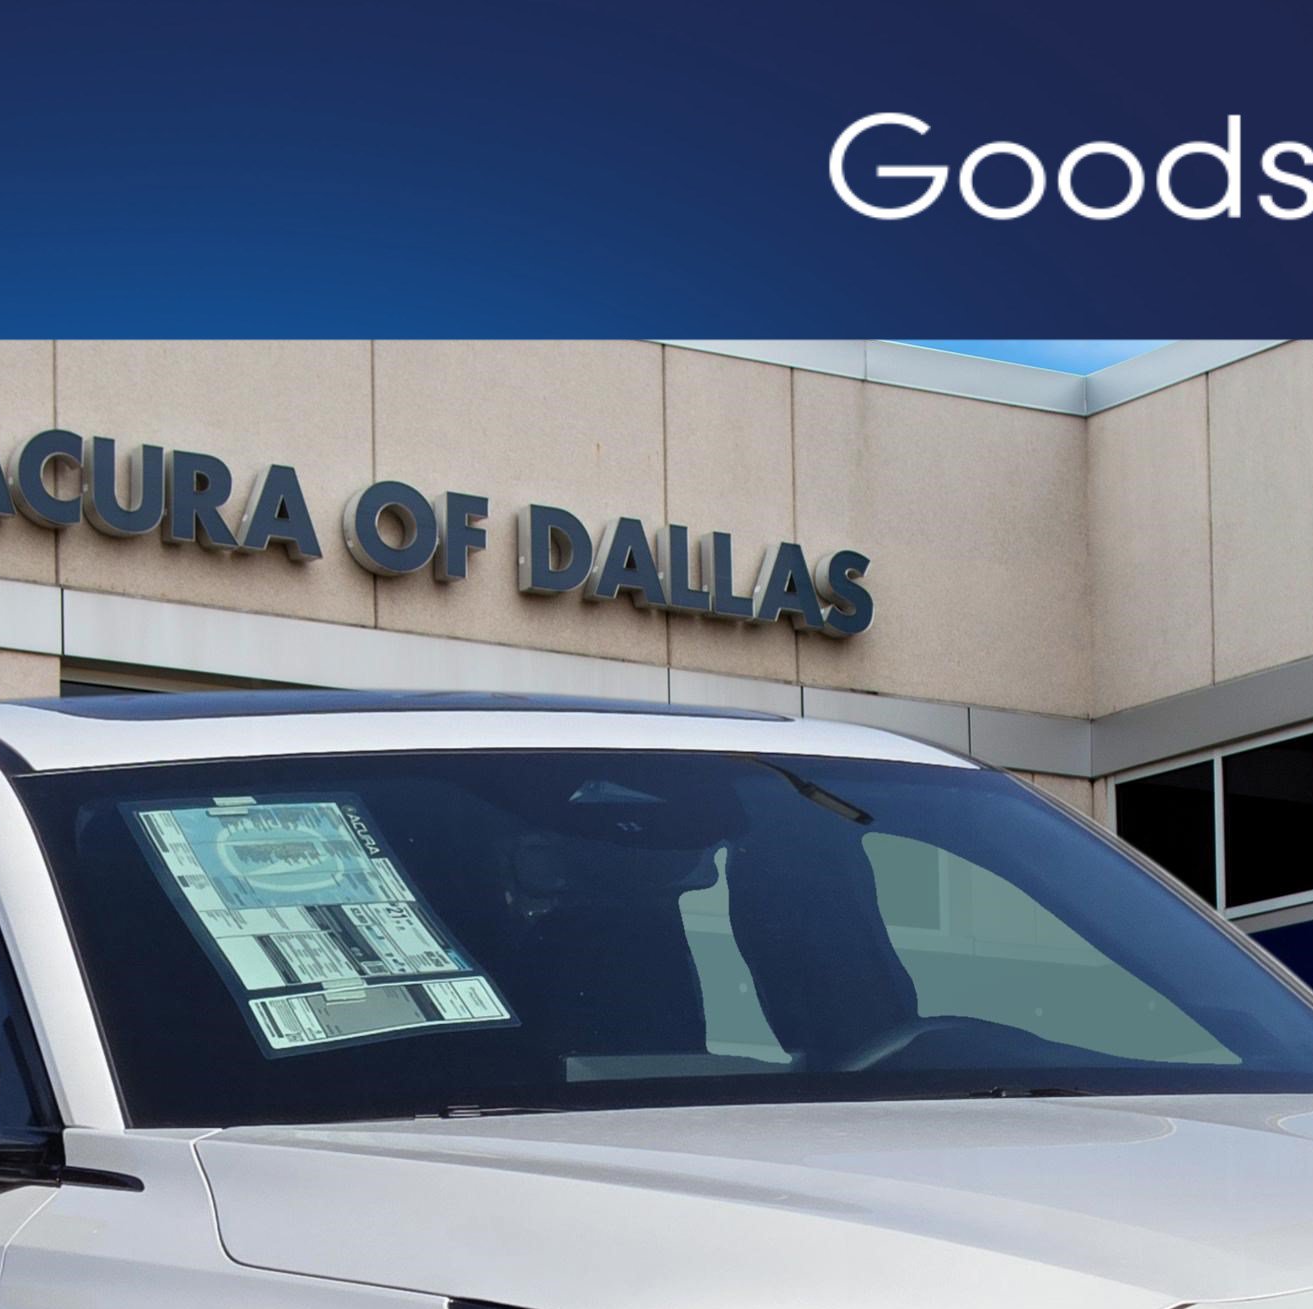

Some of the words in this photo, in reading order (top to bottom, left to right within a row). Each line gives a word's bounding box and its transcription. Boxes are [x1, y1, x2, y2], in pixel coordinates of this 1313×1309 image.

[345, 480, 488, 582] OF
[518, 503, 875, 639] DALLAS
[348, 813, 381, 855] ACURA
